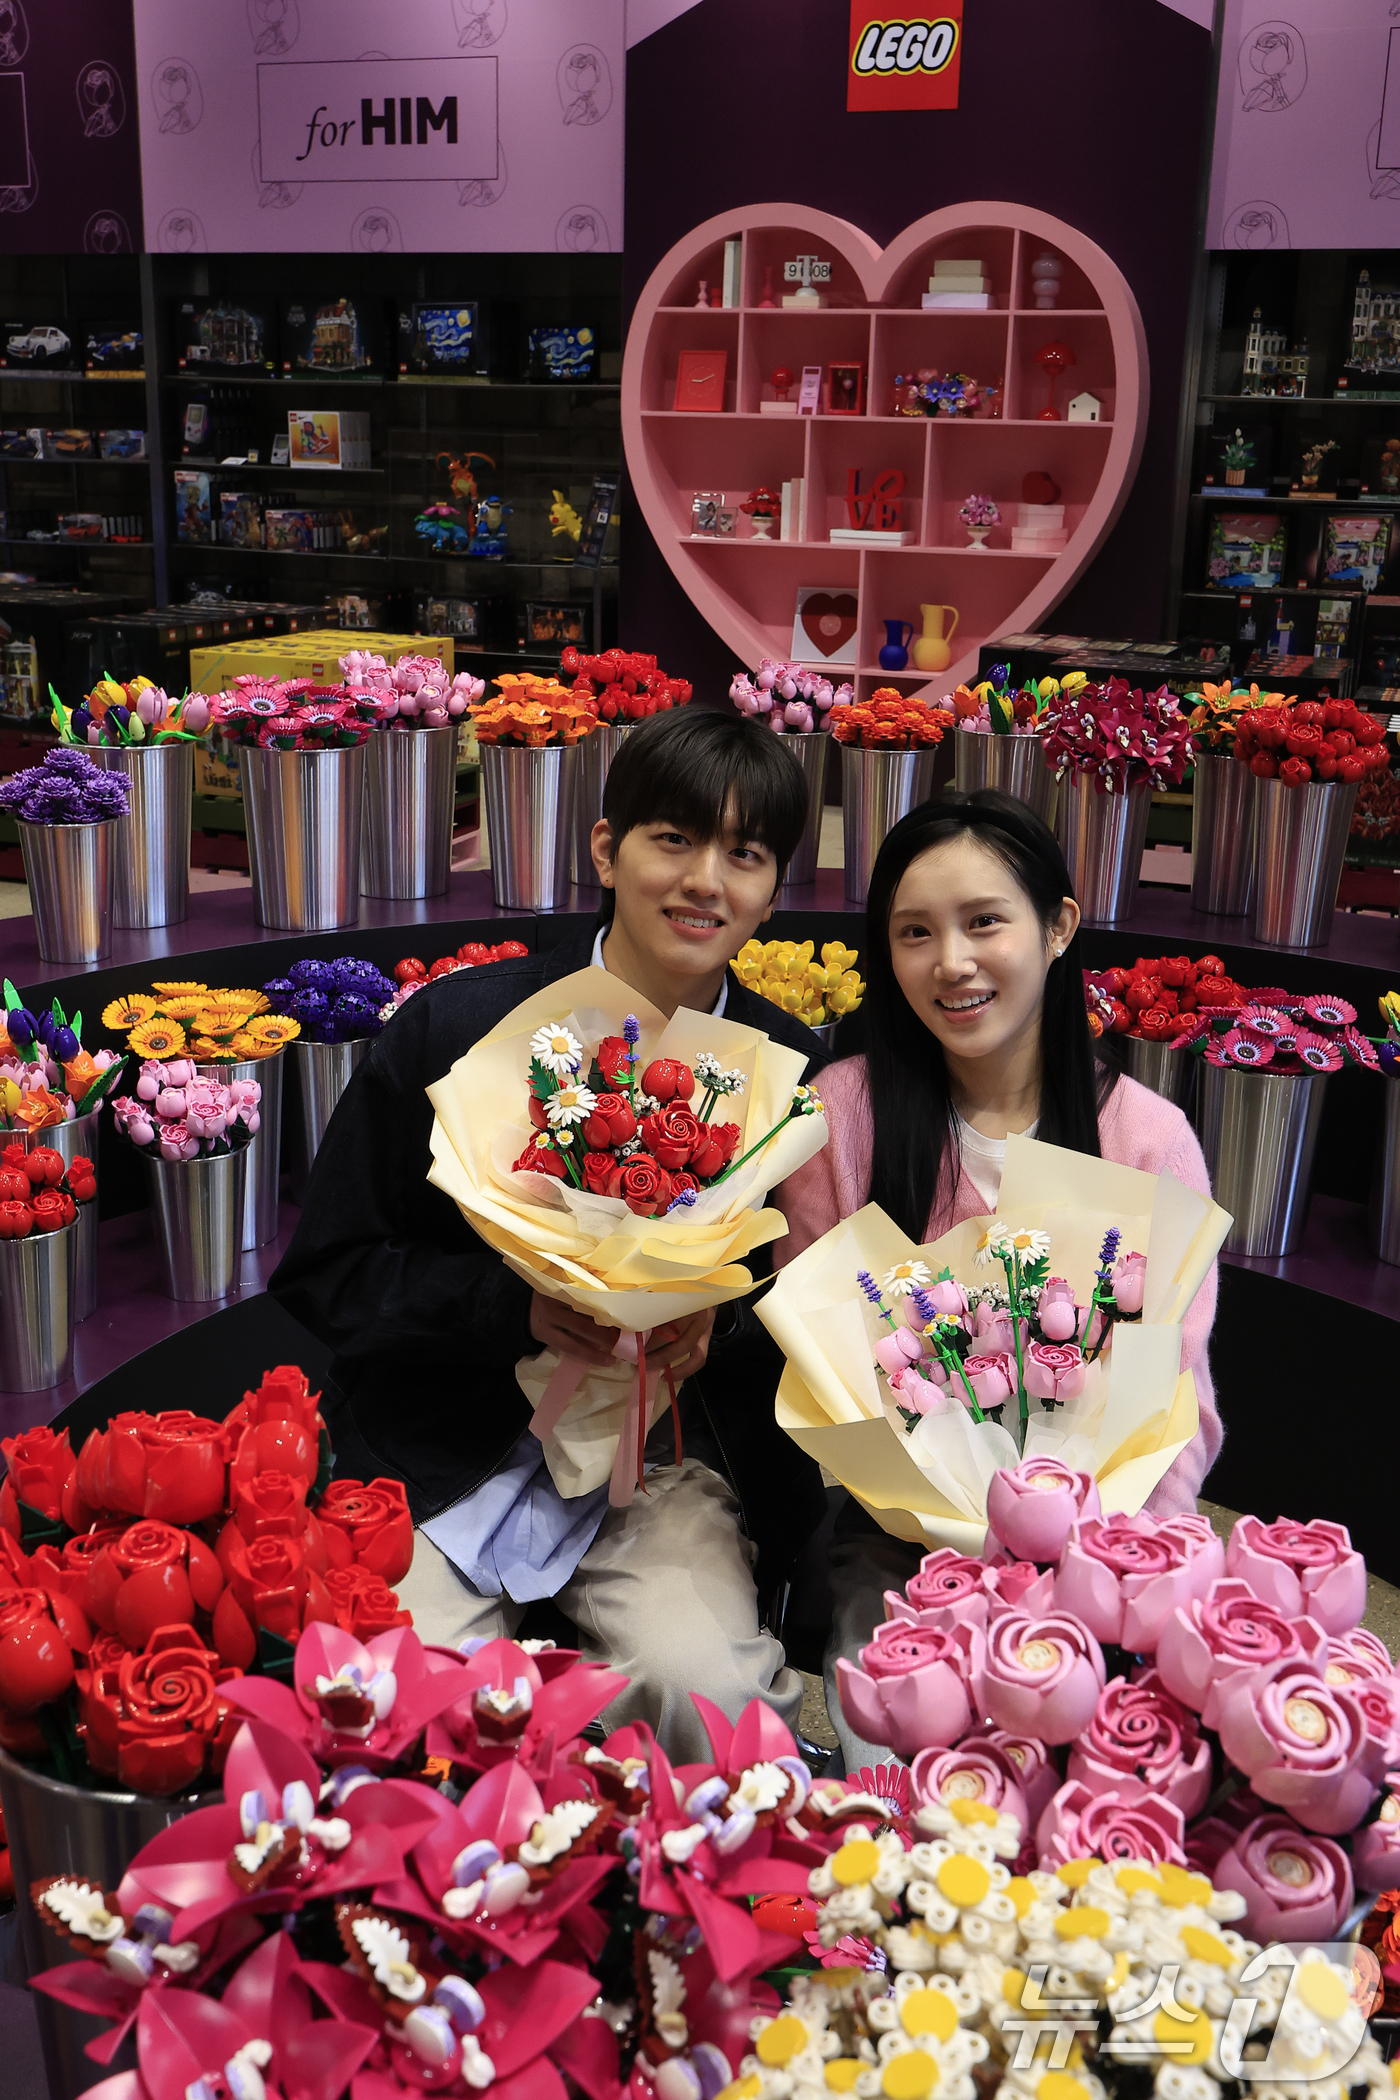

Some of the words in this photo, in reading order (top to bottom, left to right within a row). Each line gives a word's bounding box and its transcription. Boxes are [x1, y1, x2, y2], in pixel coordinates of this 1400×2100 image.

[857, 23, 955, 71] LEGO
[296, 106, 356, 161] for
[361, 96, 458, 146] HIM
[788, 264, 797, 278] 9
[812, 264, 829, 278] 08
